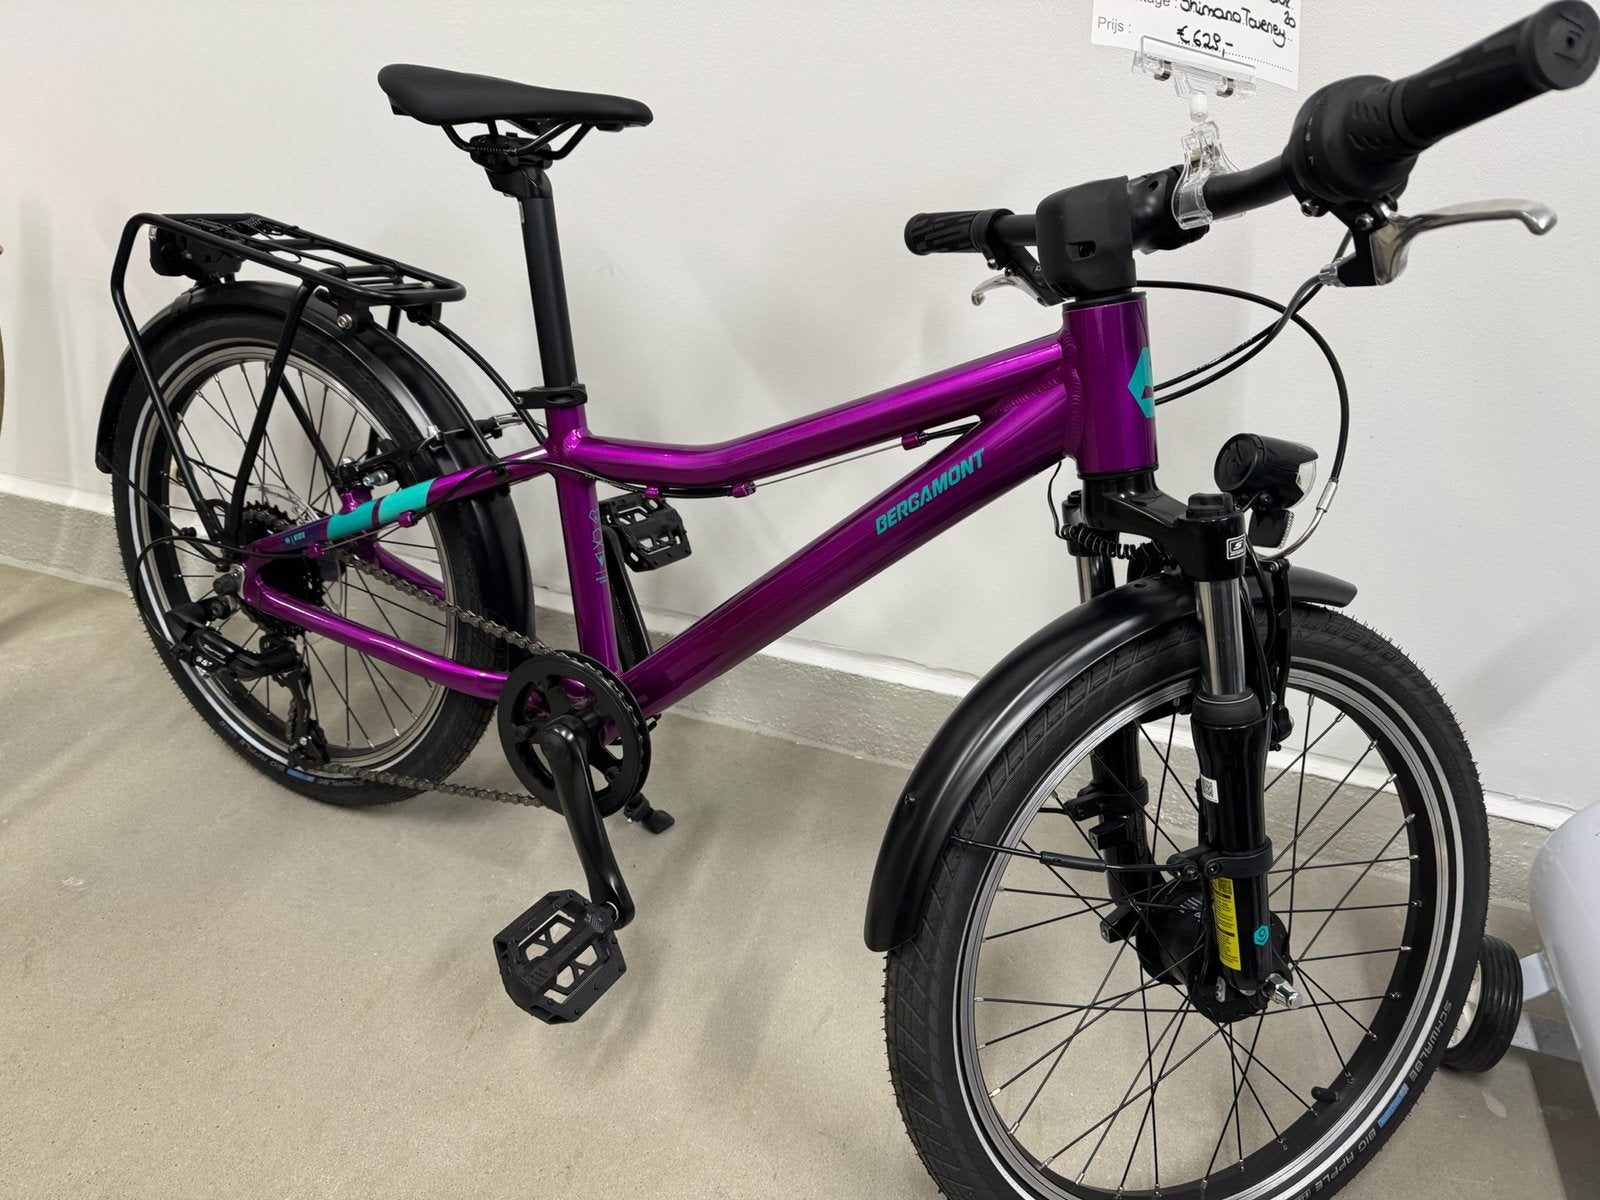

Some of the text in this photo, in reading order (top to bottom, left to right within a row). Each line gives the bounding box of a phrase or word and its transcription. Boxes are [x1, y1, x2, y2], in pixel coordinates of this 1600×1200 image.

[1097, 16, 1124, 34] Prijs
[875, 447, 985, 536] BERGAMONT
[1315, 1000, 1452, 1192] SCHWALBE BIG APPLE
